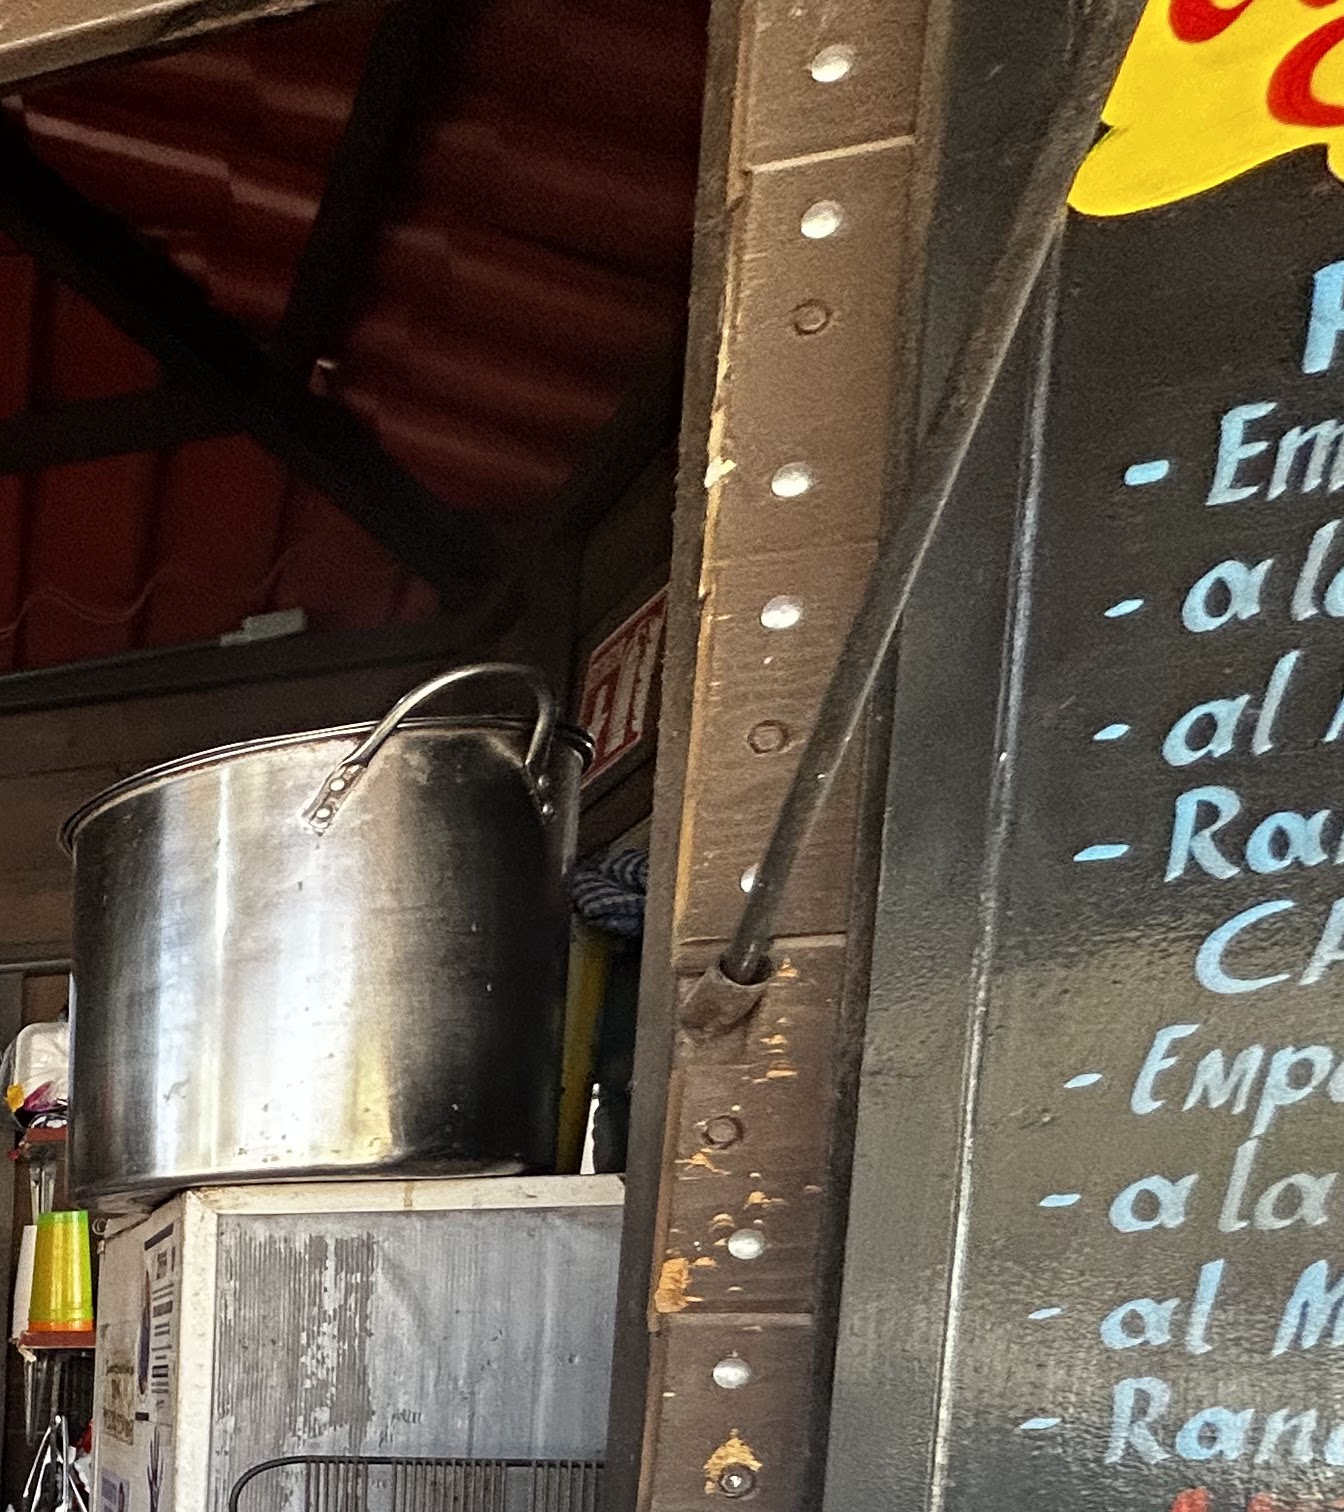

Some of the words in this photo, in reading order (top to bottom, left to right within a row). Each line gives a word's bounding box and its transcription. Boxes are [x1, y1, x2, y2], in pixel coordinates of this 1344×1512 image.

[1161, 650, 1300, 767] al
[1164, 784, 1344, 883] Ra
[1129, 1023, 1344, 1143] Emp
[1109, 1174, 1199, 1234] a
[1100, 1259, 1225, 1356] al
